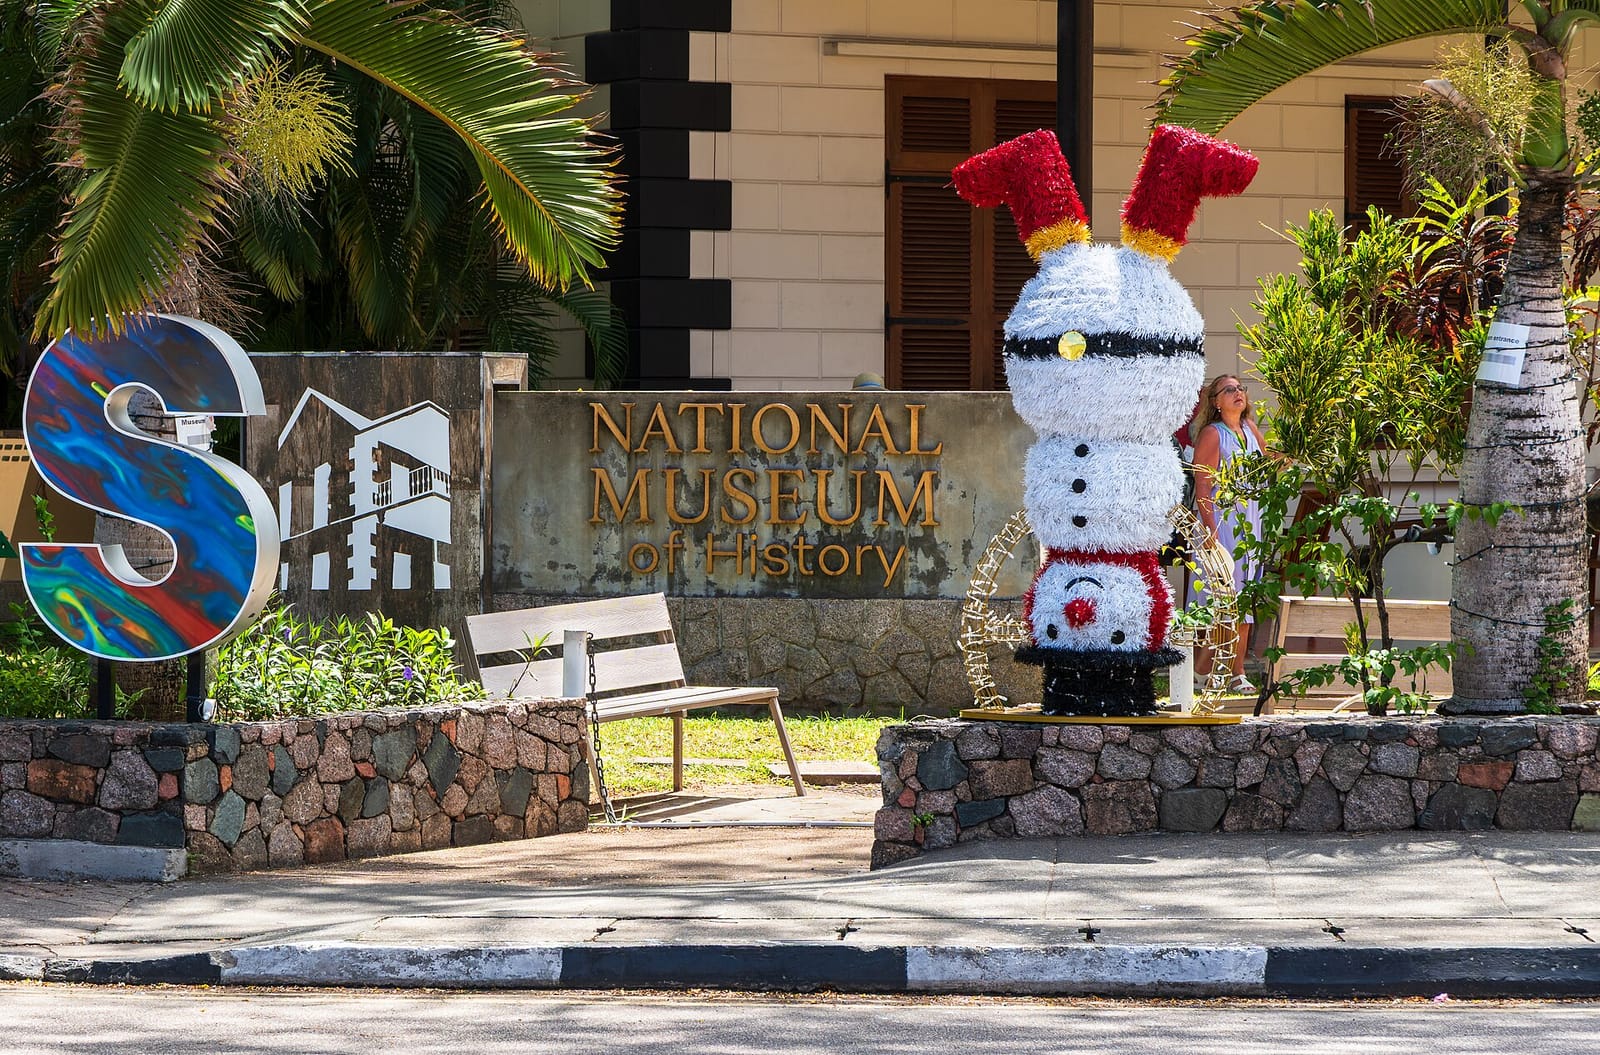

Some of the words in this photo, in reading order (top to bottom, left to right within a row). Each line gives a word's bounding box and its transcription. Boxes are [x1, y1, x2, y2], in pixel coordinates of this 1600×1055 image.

[588, 402, 943, 456] NATIONAL
[19, 312, 280, 662] S
[589, 467, 941, 527] MUSEUM
[627, 530, 684, 575] of
[706, 531, 906, 588] History
